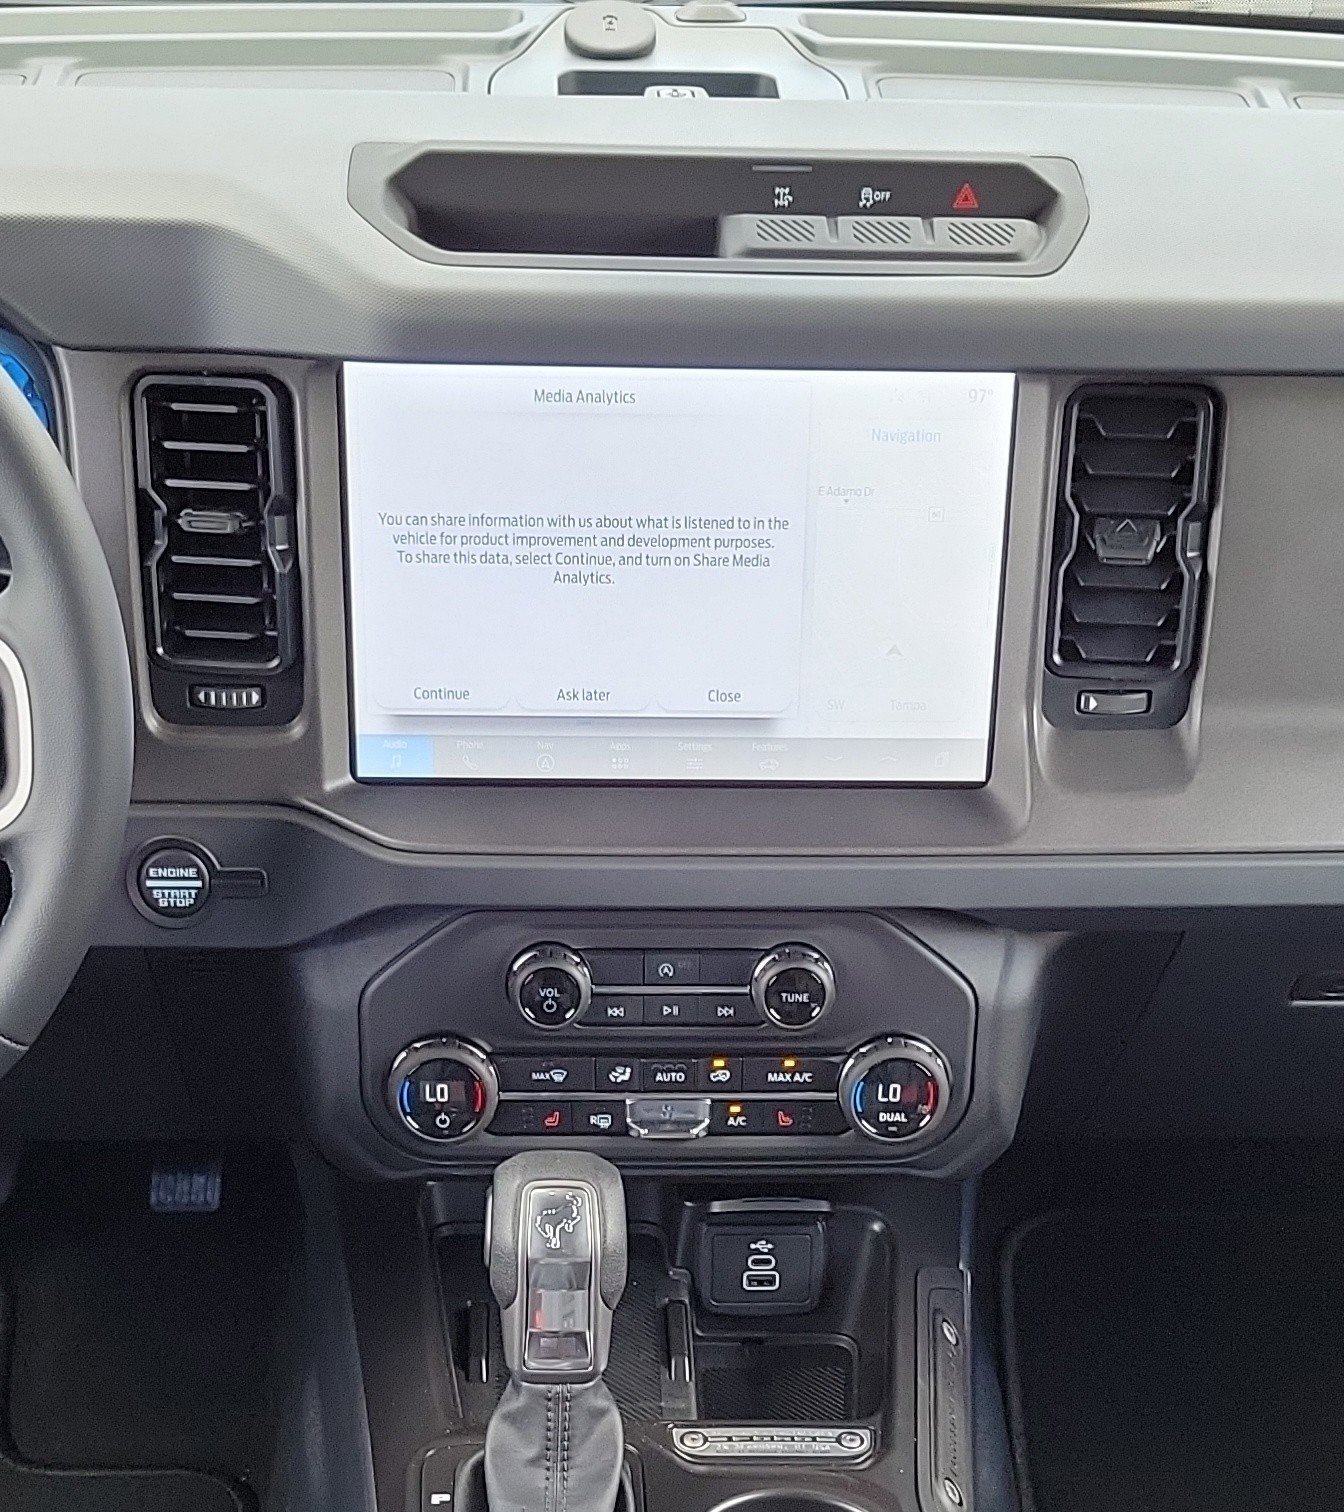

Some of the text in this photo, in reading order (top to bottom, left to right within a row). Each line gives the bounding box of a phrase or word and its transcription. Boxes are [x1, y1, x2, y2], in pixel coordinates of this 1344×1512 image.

[873, 190, 891, 201] OFF
[534, 388, 636, 405] Media Analytics
[871, 428, 943, 445] Navigation
[378, 512, 790, 531] You can share information with us about what is listened to in the
[392, 531, 775, 551] vehicle for product improvement and development purposes.
[397, 550, 771, 568] To share this data, select Continue, and turn on Share Media
[553, 570, 616, 587] Analytics.
[413, 686, 471, 701] Continue
[556, 687, 611, 702] Ask later
[707, 689, 742, 703] Close
[537, 740, 554, 750] Nav
[677, 741, 713, 753] Settings
[149, 867, 198, 878] ENGINE
[152, 889, 198, 899] START
[158, 898, 195, 908] STOP
[539, 987, 561, 998] VOL
[780, 992, 810, 1004] TUNE
[531, 1072, 550, 1080] MAX
[655, 1072, 686, 1082] AUTO
[767, 1072, 813, 1083] MAX A/C
[425, 1083, 449, 1103] LO
[877, 1083, 901, 1103] LO
[727, 1115, 747, 1127] A/C
[878, 1112, 908, 1123] DUAL
[430, 1493, 451, 1505] P
